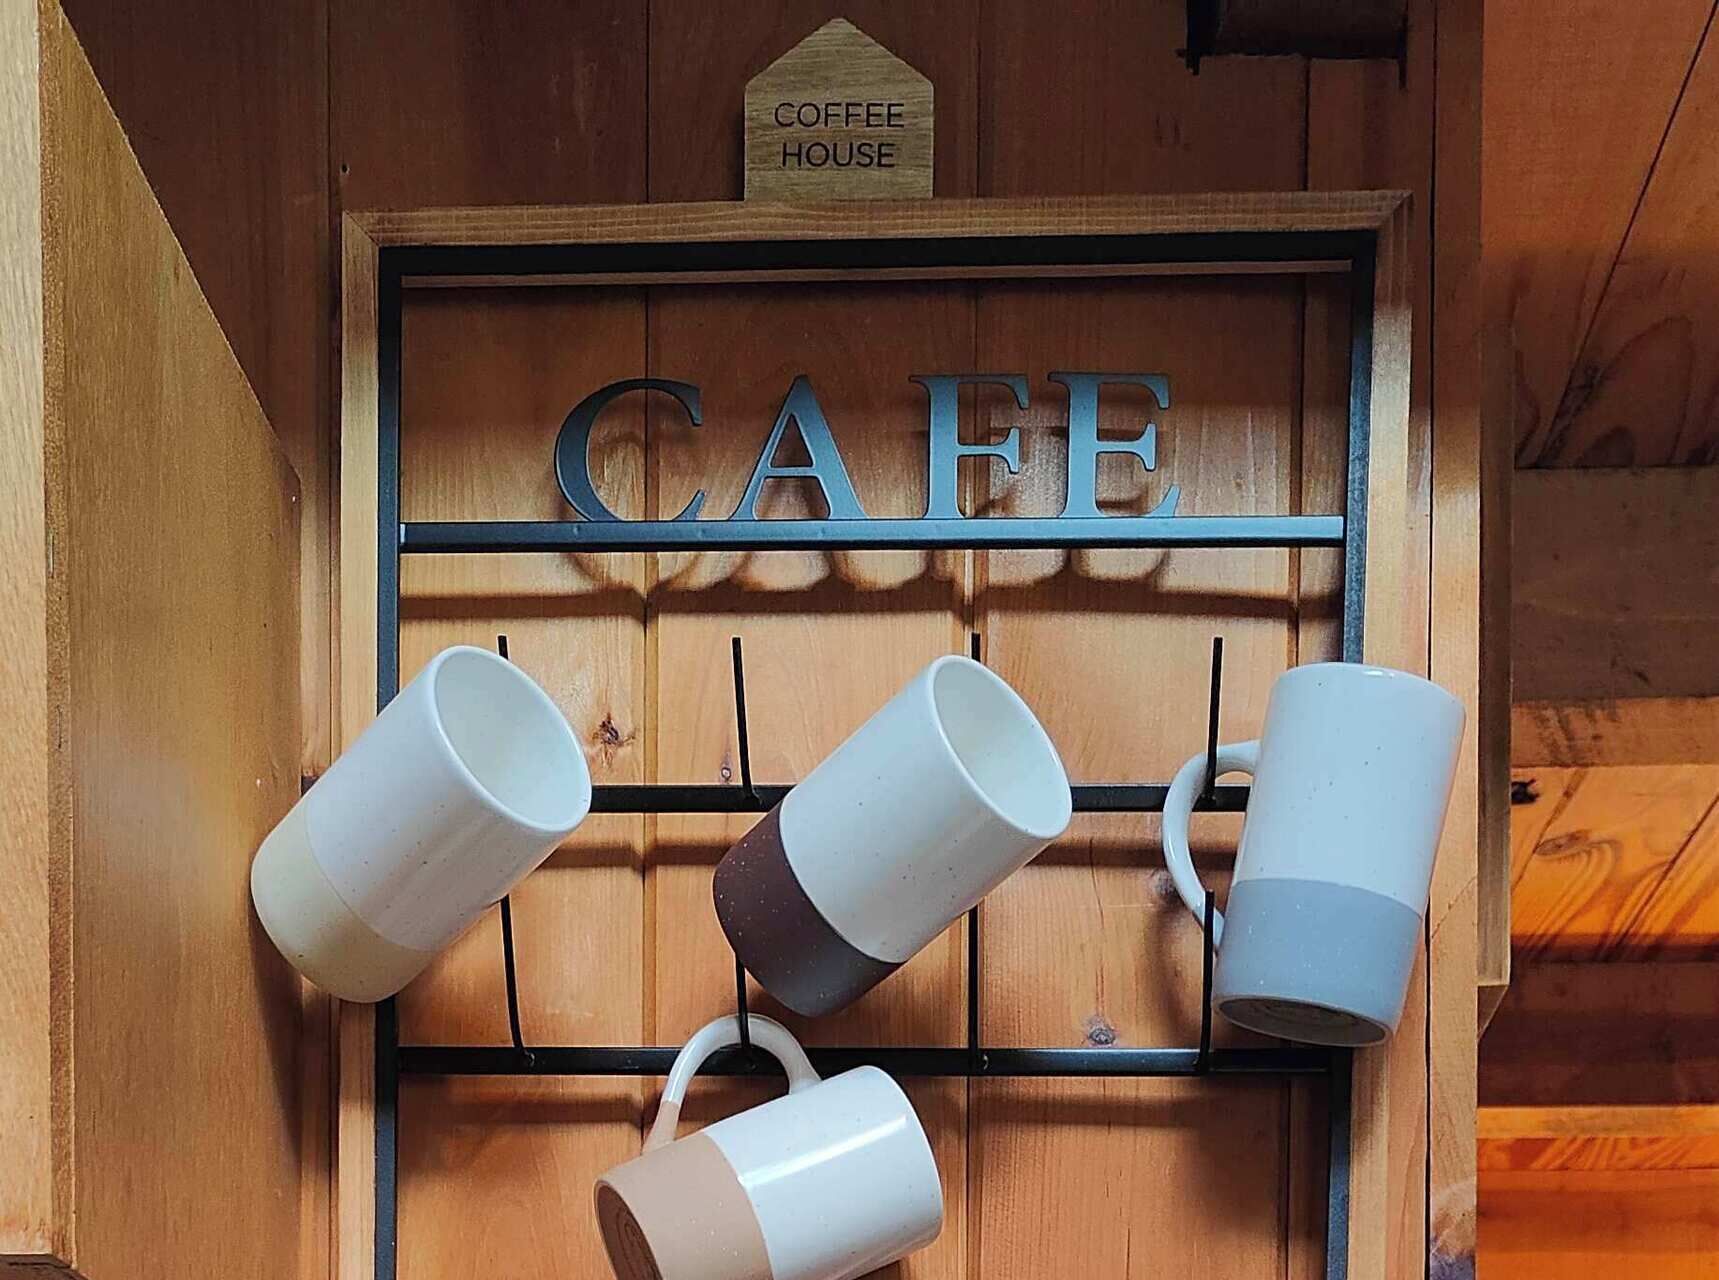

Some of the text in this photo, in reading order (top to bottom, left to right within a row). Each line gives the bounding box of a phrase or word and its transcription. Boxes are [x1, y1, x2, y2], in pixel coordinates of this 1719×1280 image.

[774, 102, 905, 128] COFFEE
[782, 142, 896, 168] HOUSE
[555, 372, 1179, 520] CAFE
